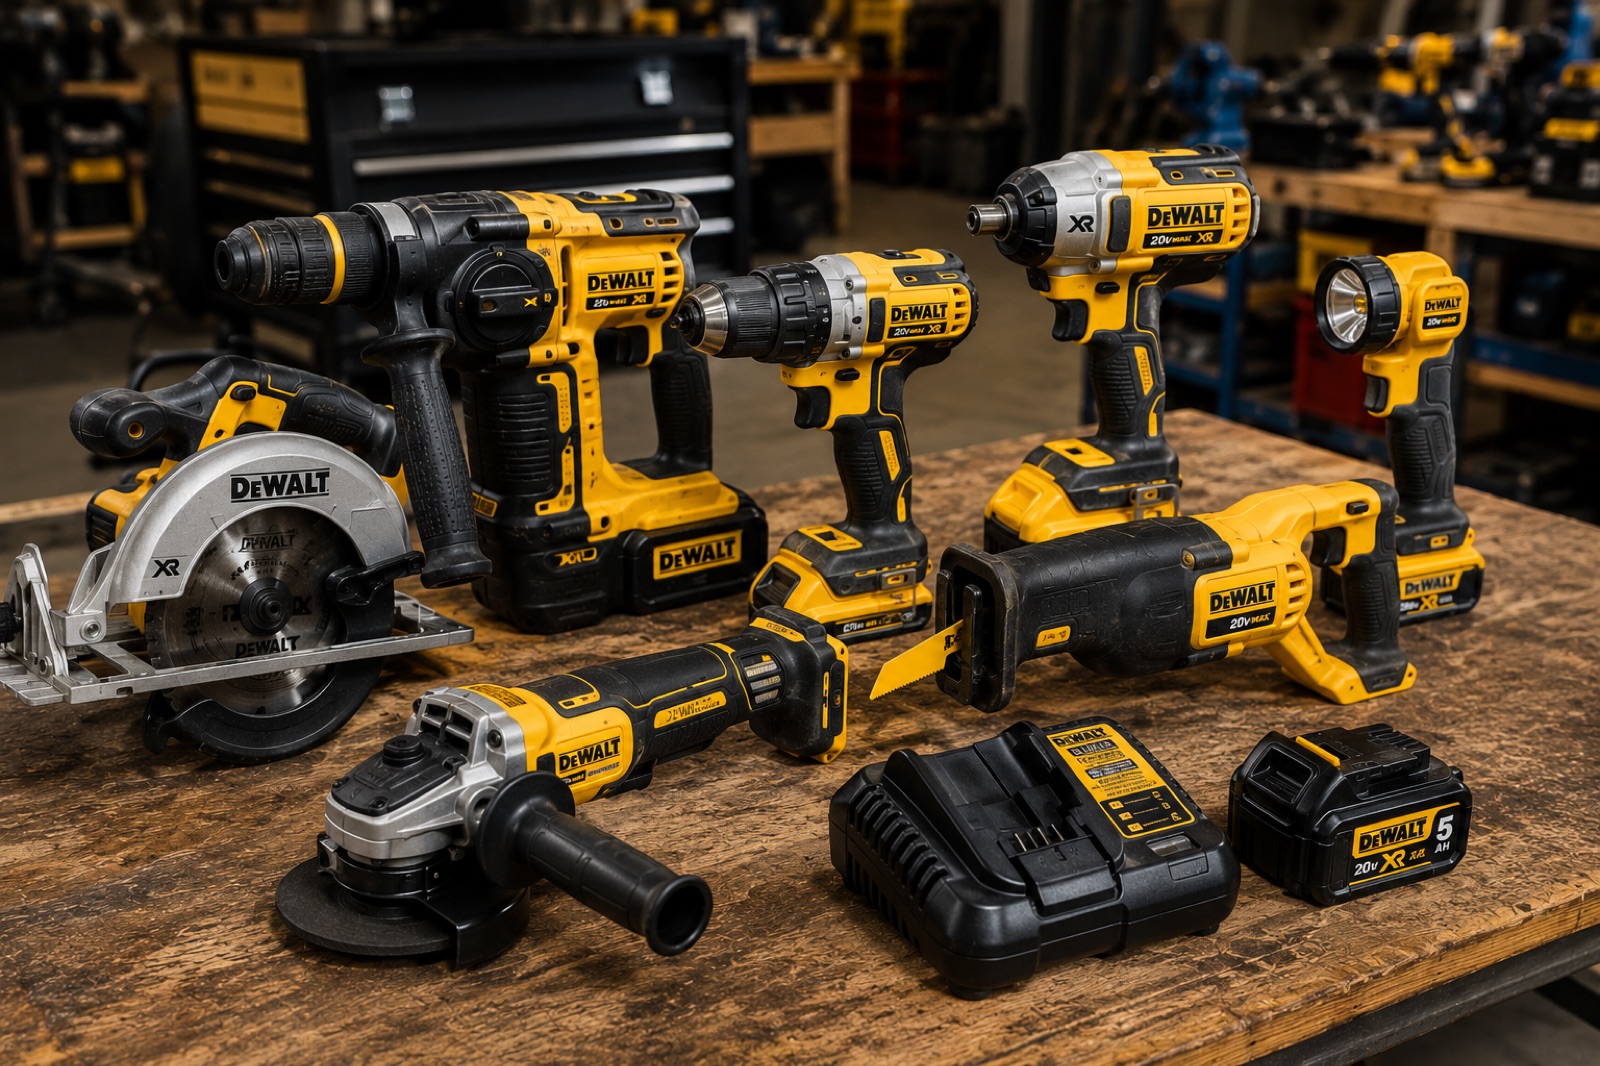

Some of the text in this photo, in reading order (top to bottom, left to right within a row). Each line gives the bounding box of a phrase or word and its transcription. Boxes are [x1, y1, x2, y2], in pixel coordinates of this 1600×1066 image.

[1067, 215, 1095, 233] XR
[152, 559, 180, 578] XR
[1436, 814, 1453, 842] 5
[1379, 849, 1405, 873] XR
